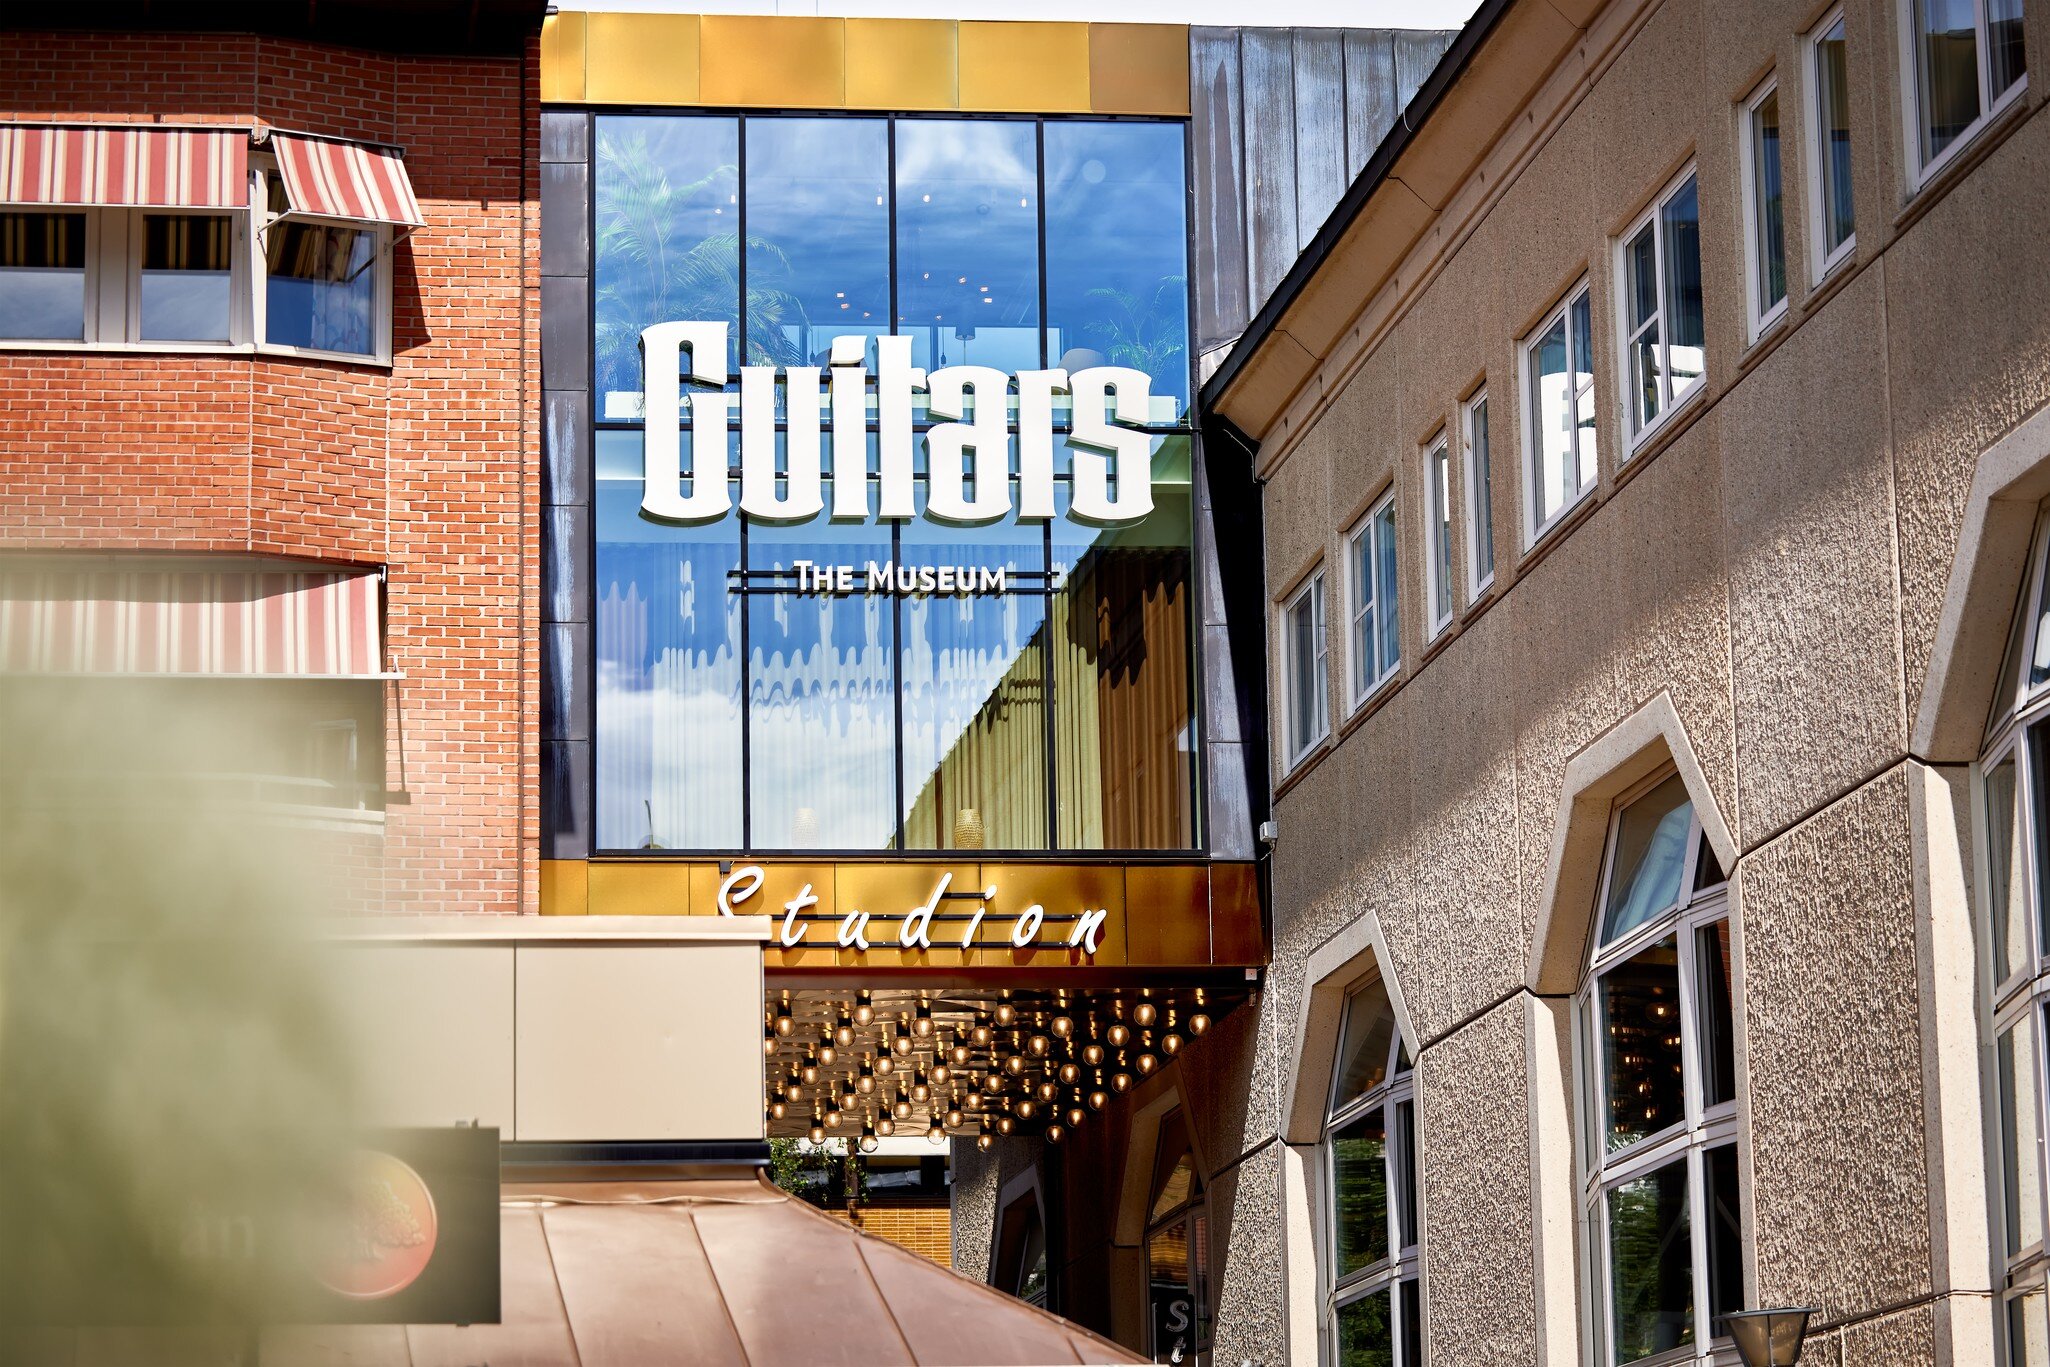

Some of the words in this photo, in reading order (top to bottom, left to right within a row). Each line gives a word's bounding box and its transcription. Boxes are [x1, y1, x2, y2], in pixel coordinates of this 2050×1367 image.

[639, 320, 1155, 525] Guitars
[794, 560, 853, 593] THE
[868, 560, 1006, 593] MUSEUM
